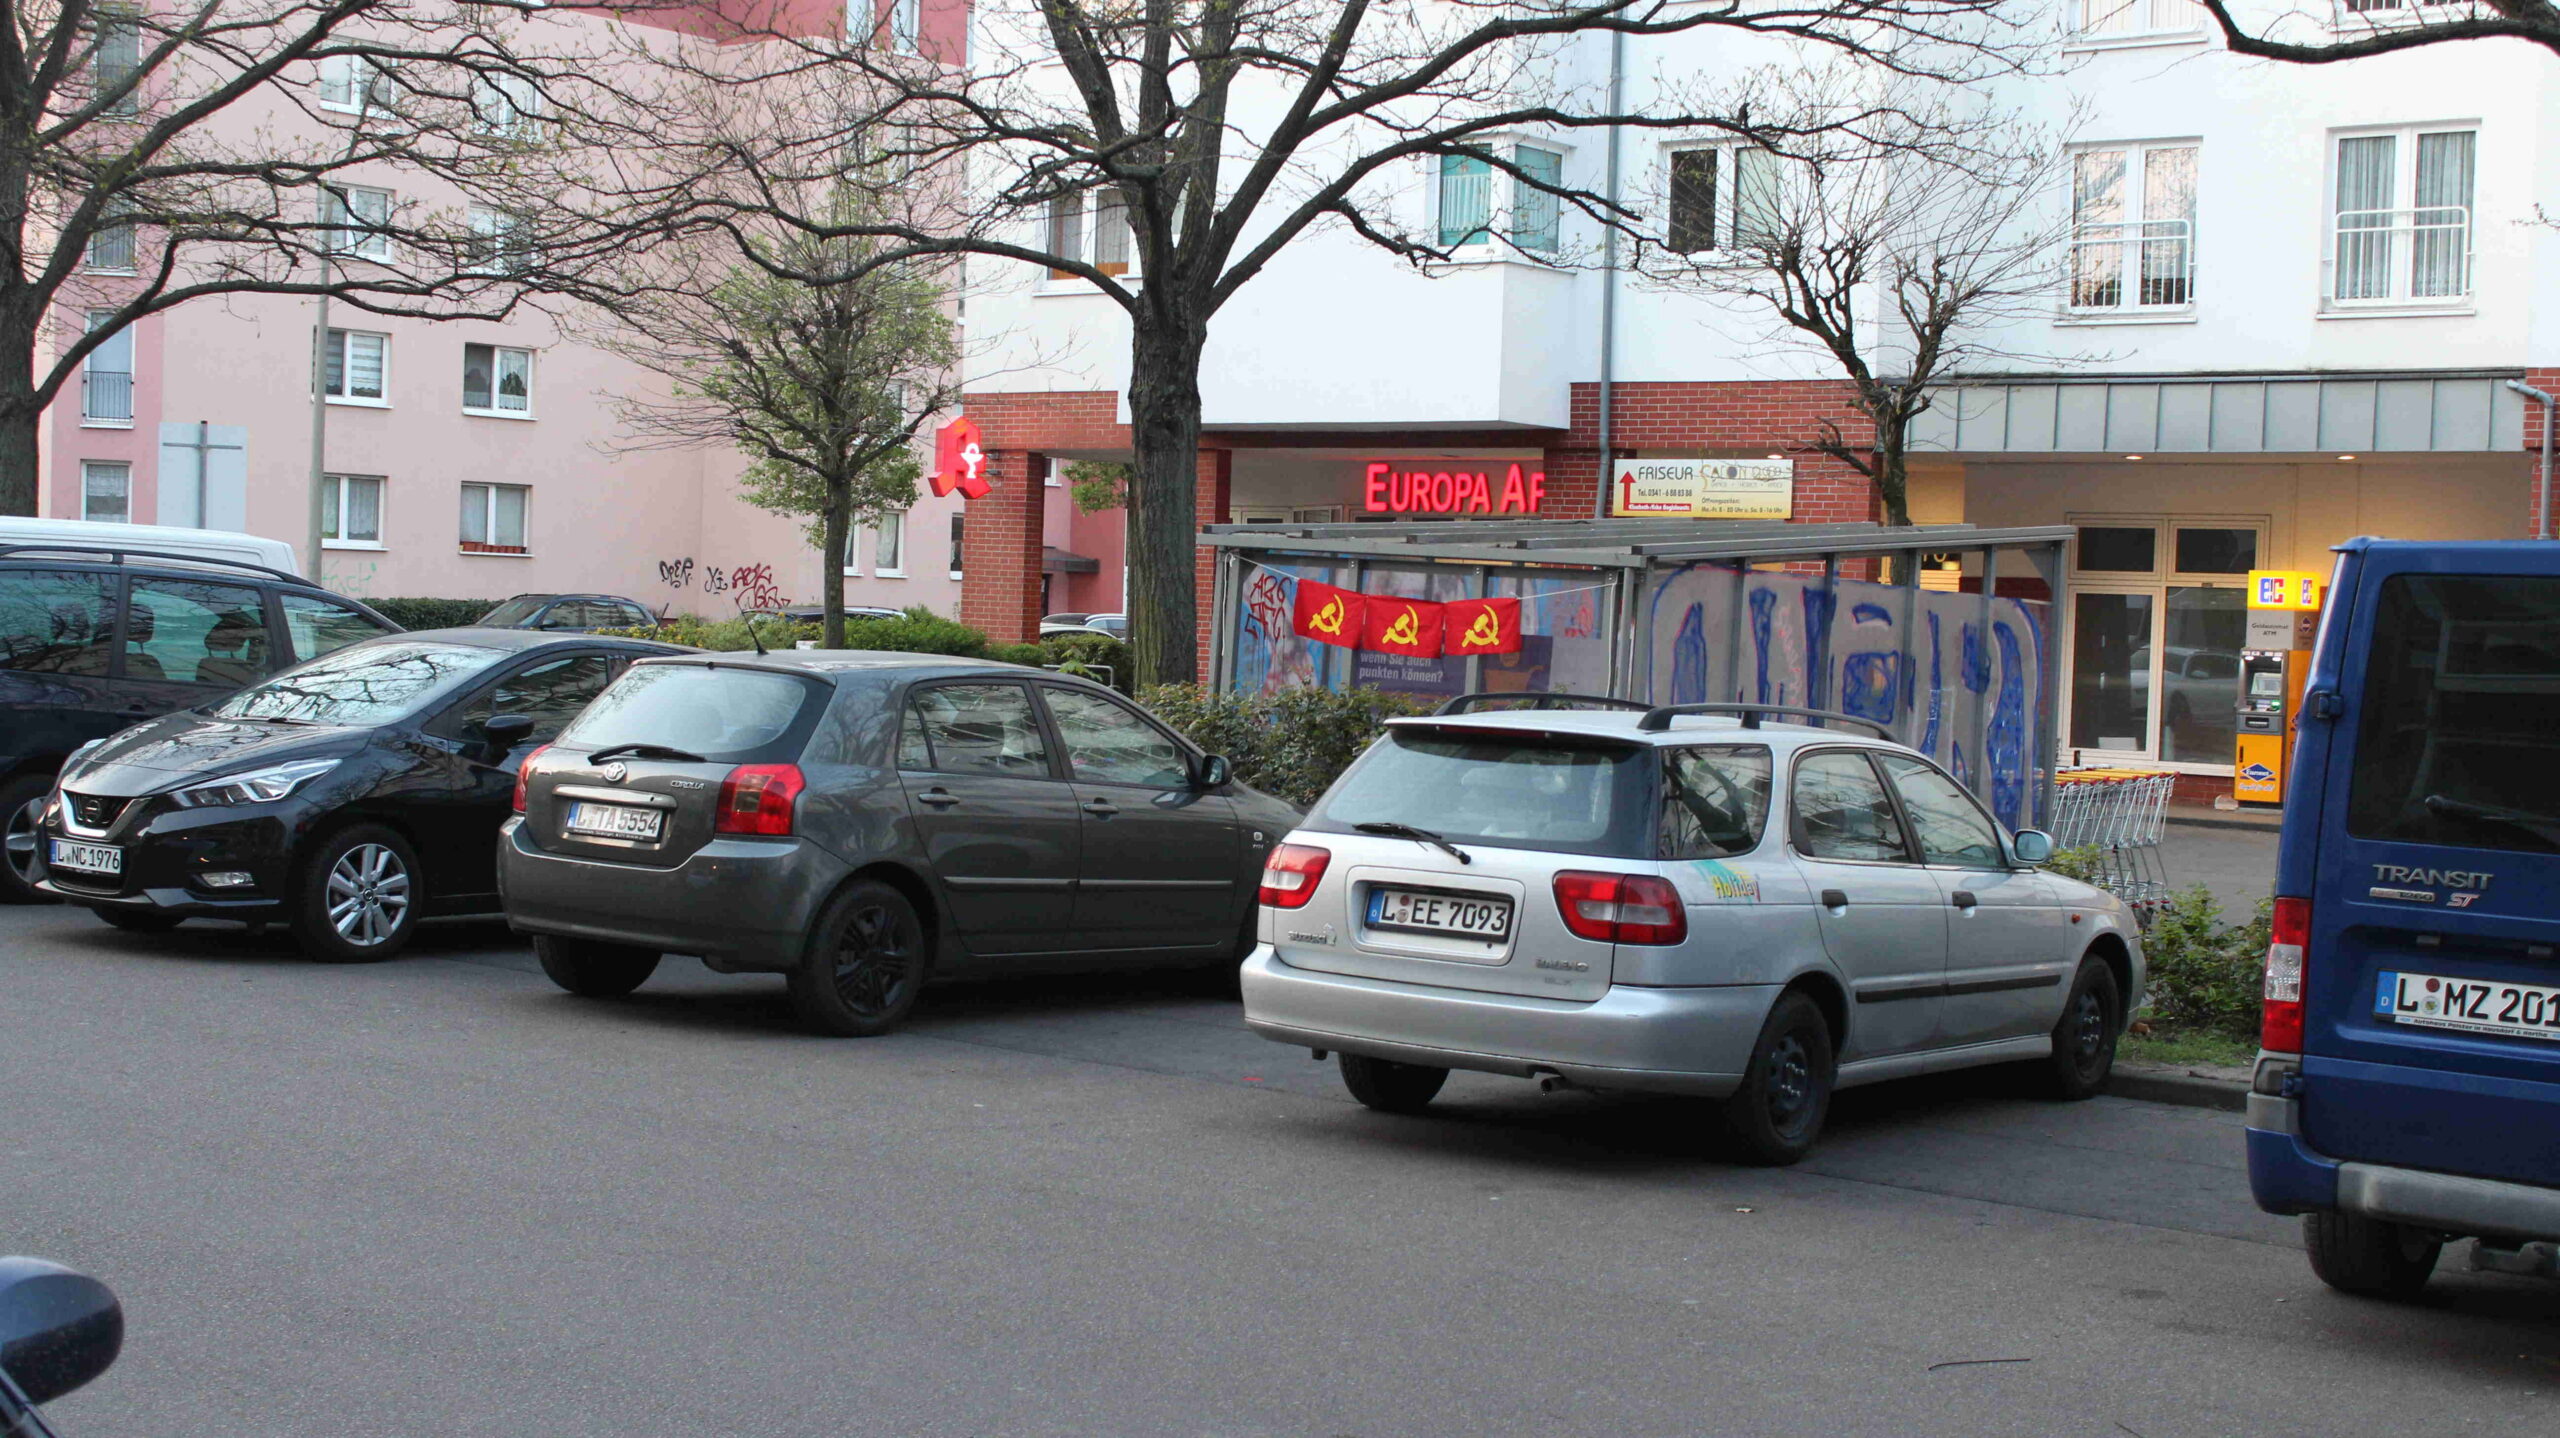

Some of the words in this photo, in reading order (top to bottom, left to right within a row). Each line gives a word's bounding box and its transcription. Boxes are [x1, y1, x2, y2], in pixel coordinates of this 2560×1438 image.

[1638, 466, 1693, 480] FRISEUR
[1365, 463, 1493, 512] EUROPA
[1360, 653, 1386, 664] wenn
[1389, 654, 1404, 665] Sie
[1360, 667, 1398, 679] punkten
[1402, 668, 1443, 682] können?
[576, 805, 586, 826] L
[597, 807, 615, 829] TA
[617, 808, 659, 834] 5554
[57, 843, 64, 862] L
[72, 846, 86, 865] NC
[89, 848, 120, 869] 1976
[1712, 873, 1761, 902] Holiday
[2372, 864, 2494, 889] TRANSIT
[2446, 892, 2480, 907] ST
[1381, 895, 1395, 921] L
[1411, 899, 1443, 926] EE
[1449, 902, 1507, 931] 7093
[2397, 978, 2418, 1011] L
[2443, 982, 2491, 1020] MZ
[2498, 988, 2560, 1026] 201
